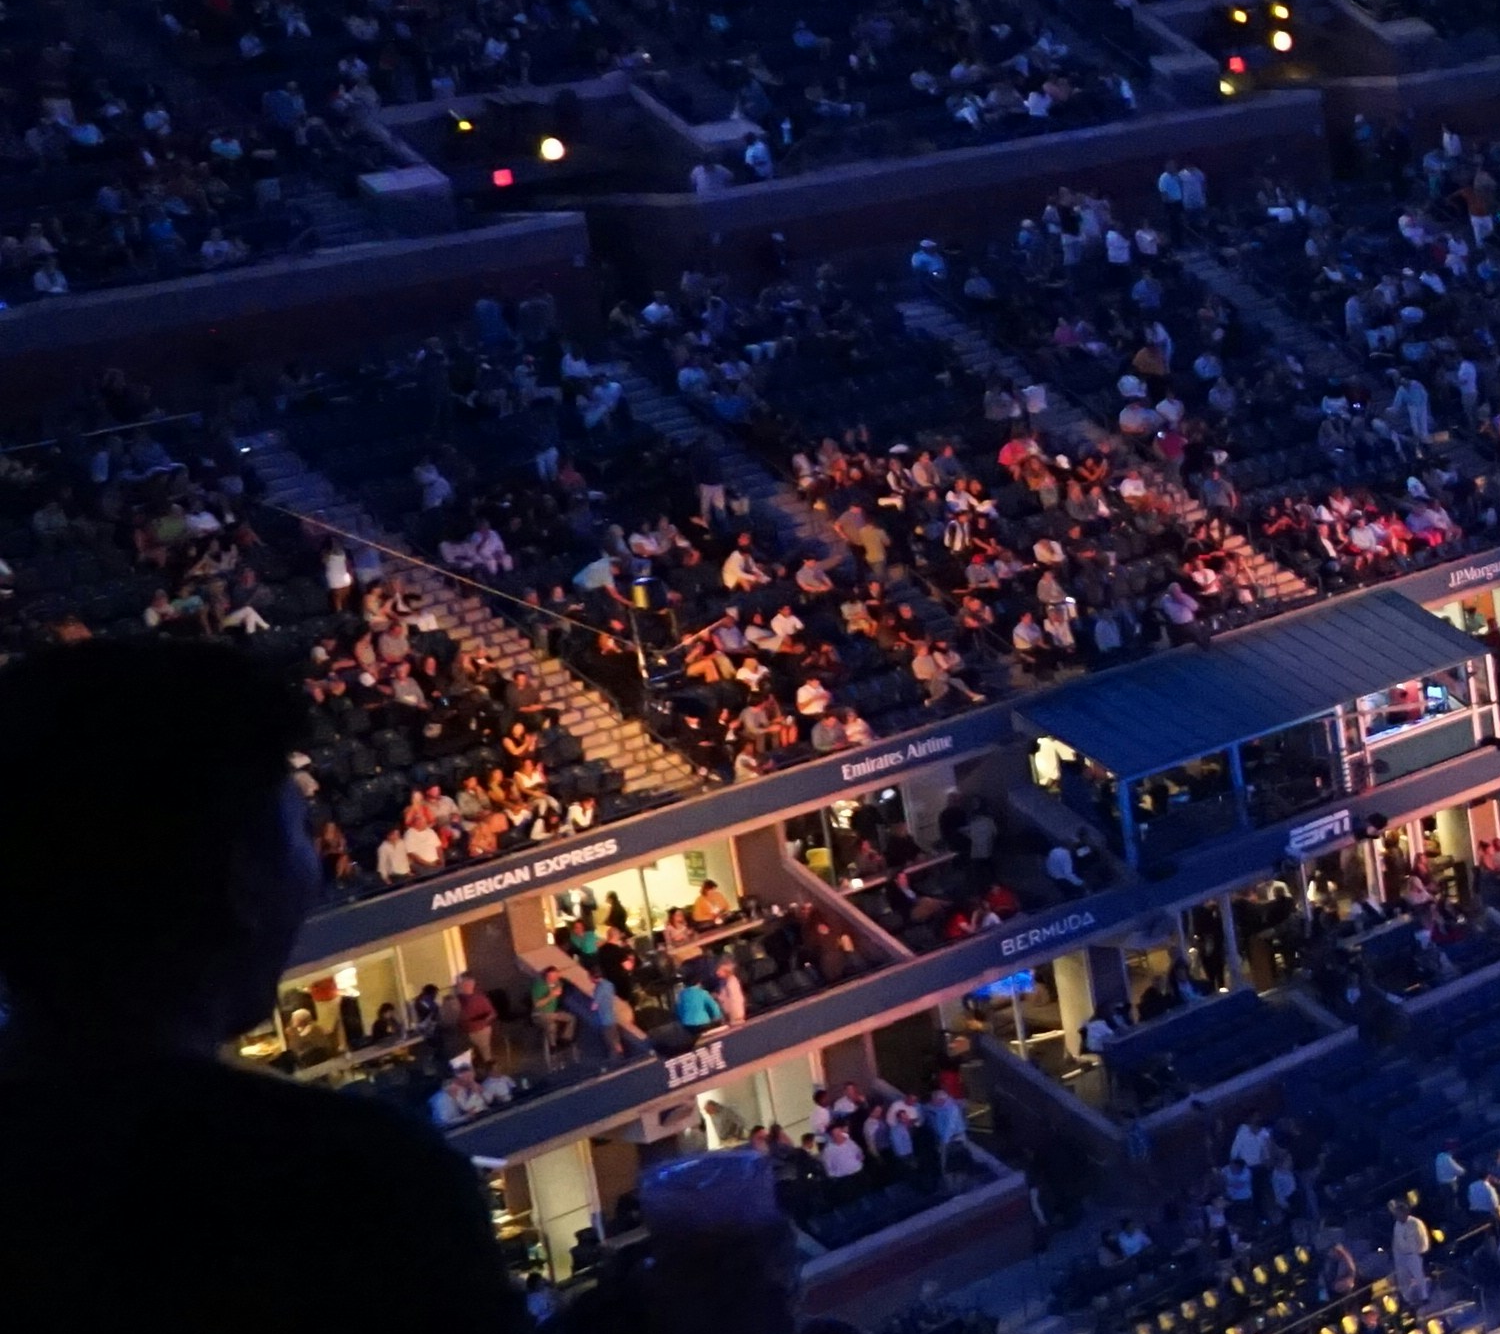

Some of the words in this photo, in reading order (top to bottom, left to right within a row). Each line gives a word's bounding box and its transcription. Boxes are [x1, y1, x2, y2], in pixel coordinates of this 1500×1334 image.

[841, 750, 904, 781] Emirates
[906, 735, 954, 760] Airline
[1289, 809, 1349, 849] ESPN
[431, 865, 531, 911] AMERICAN
[533, 838, 619, 878] EXPRESS
[1001, 911, 1097, 957] BERMUDA
[665, 1041, 727, 1088] IBM
